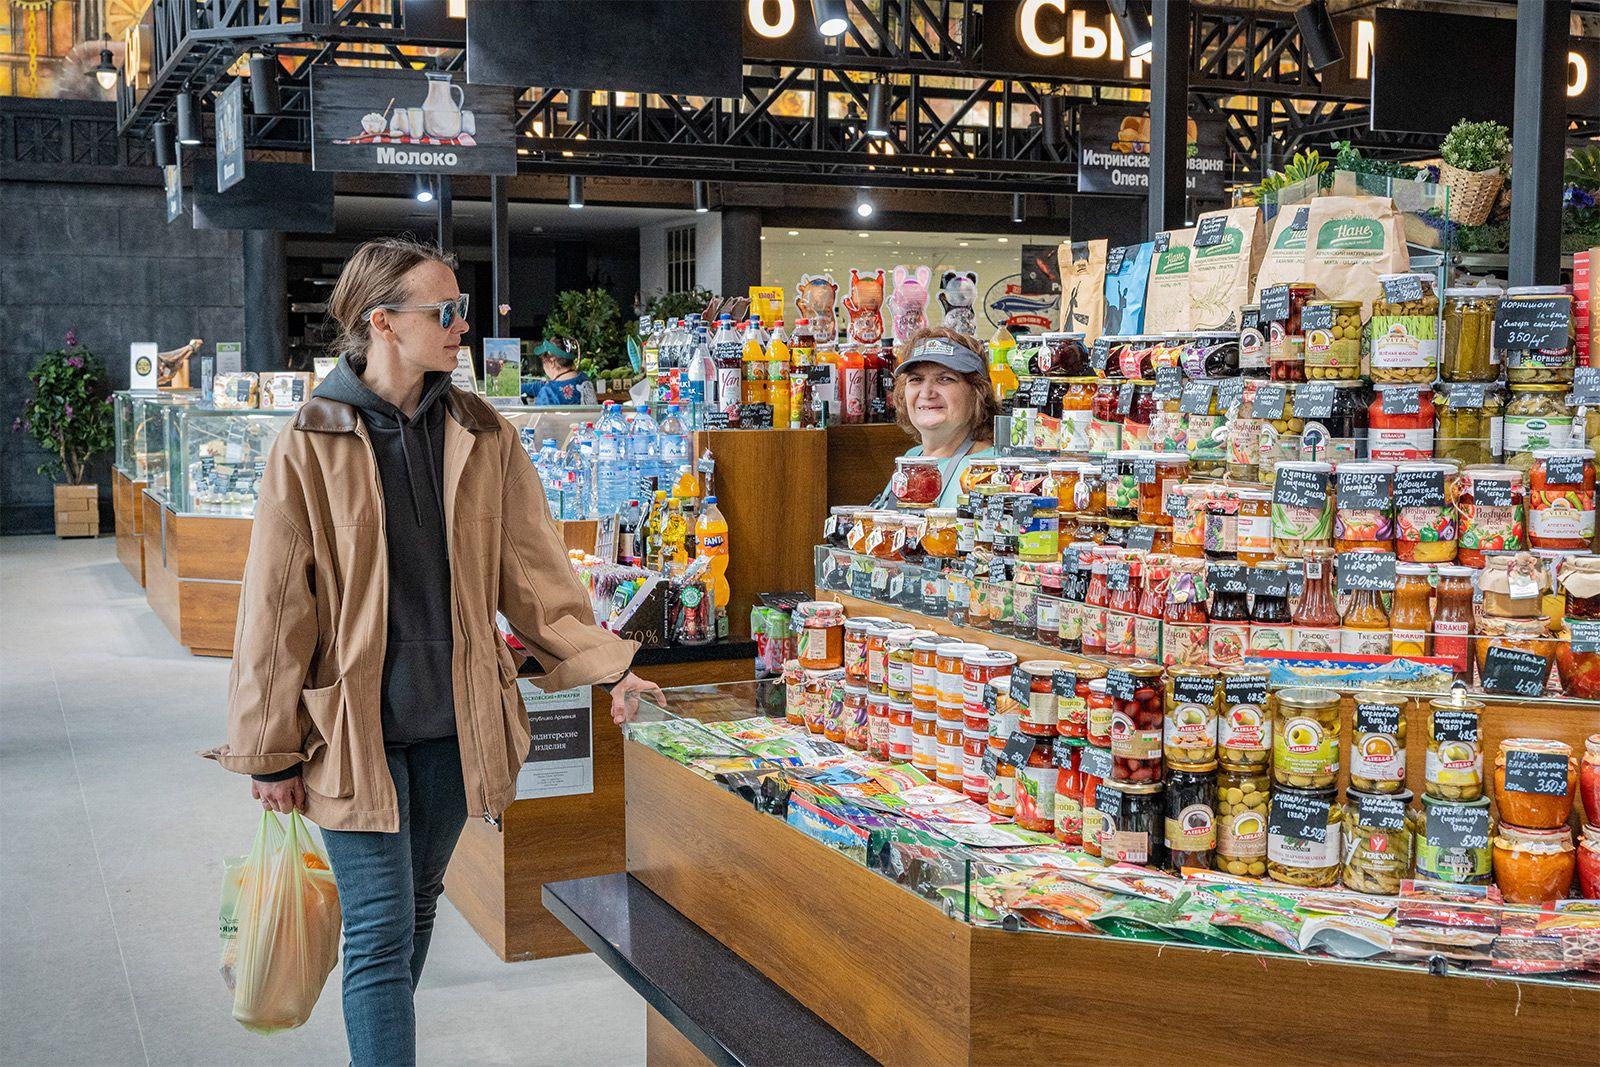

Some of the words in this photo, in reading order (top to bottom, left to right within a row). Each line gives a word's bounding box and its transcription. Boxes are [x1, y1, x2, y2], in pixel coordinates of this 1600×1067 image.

[376, 147, 458, 166] Молоко
[1083, 149, 1150, 169] Истринска
[1111, 169, 1149, 187] Олега
[721, 370, 741, 397] Yan
[1476, 506, 1512, 520] Proshyan
[530, 730, 579, 742] ондитерские
[534, 743, 567, 752] изделия
[1447, 761, 1472, 769] AIELLO
[1186, 827, 1209, 836] AIELLO
[1239, 832, 1262, 840] AIELLO
[1362, 851, 1395, 861] YEREVAN
